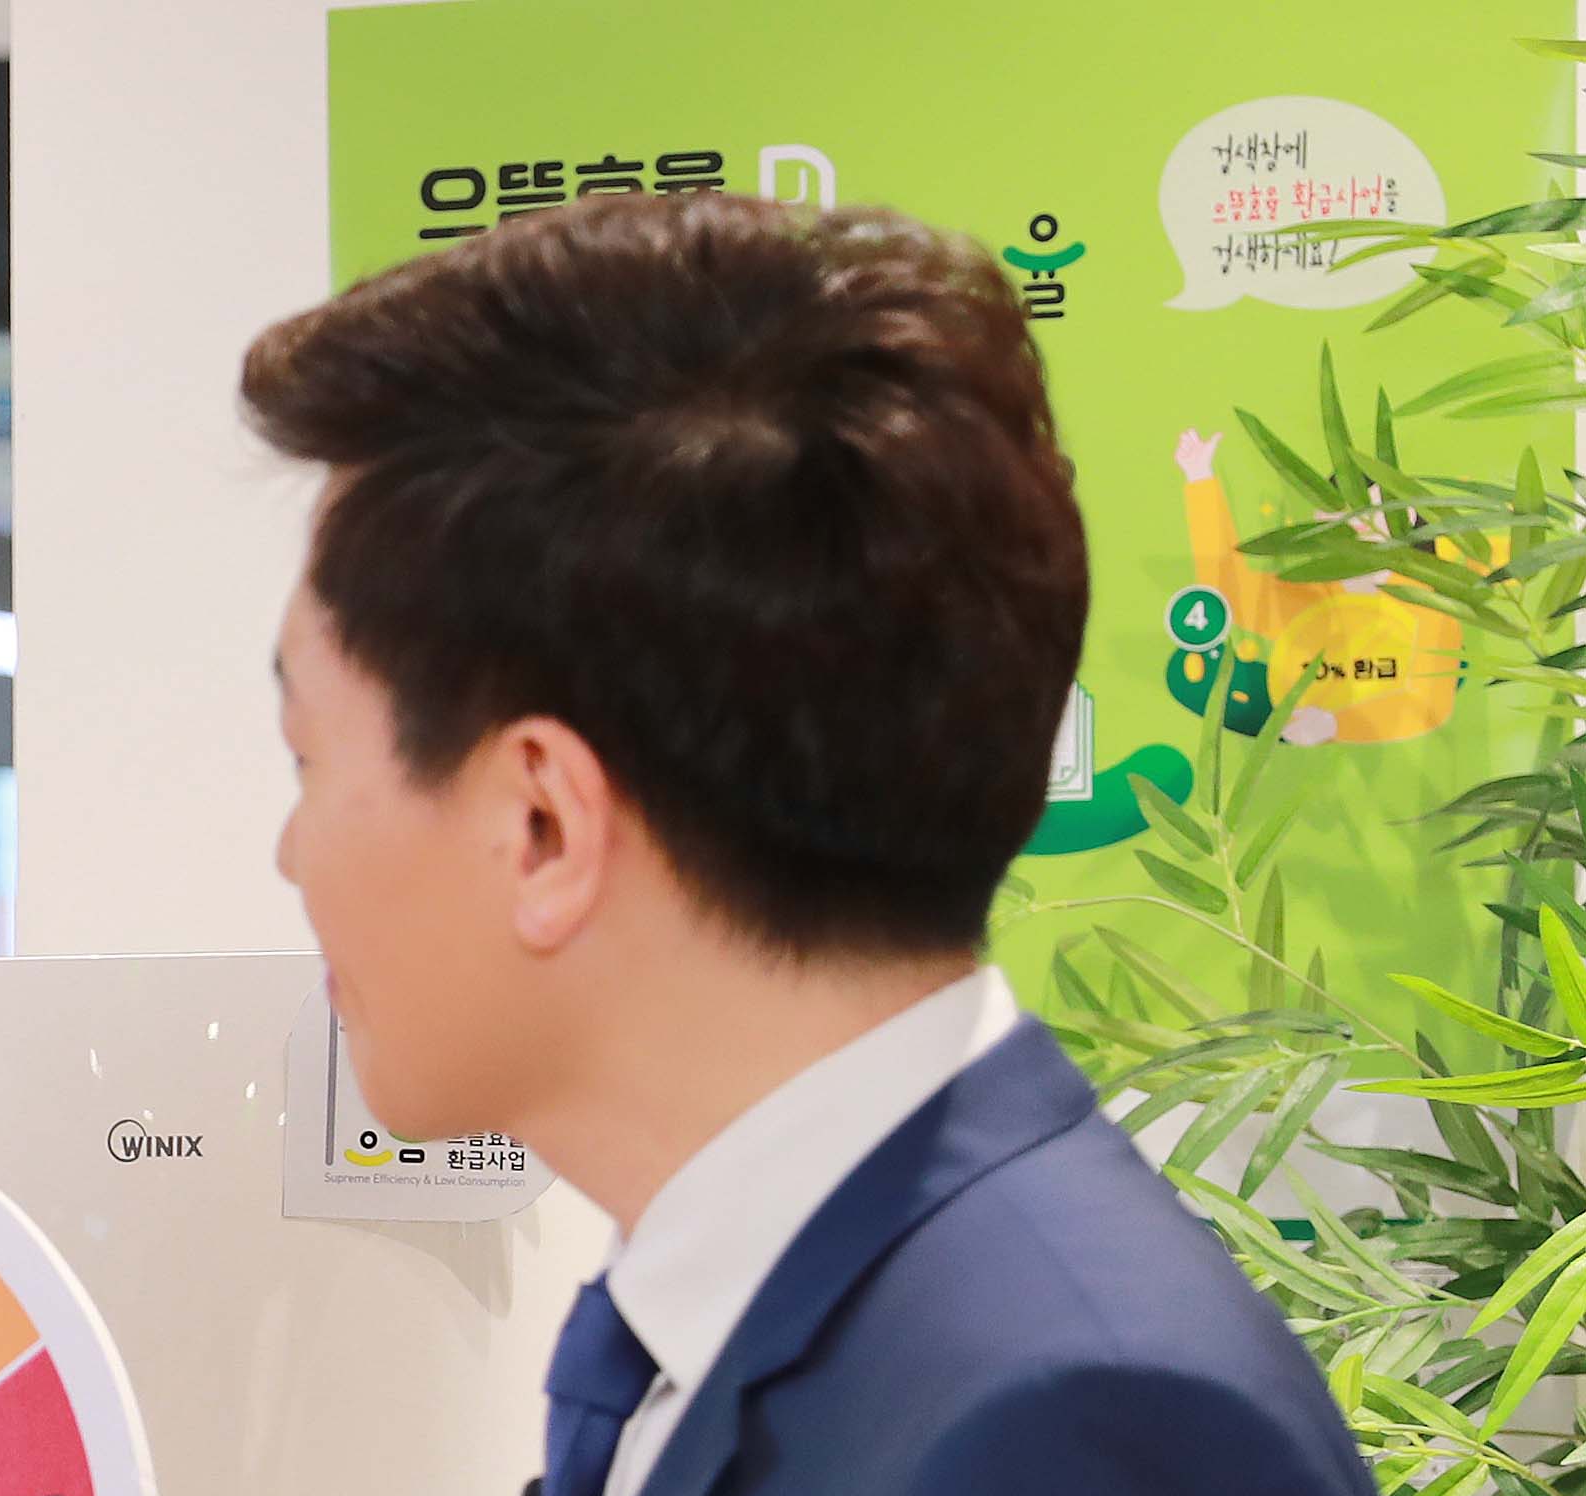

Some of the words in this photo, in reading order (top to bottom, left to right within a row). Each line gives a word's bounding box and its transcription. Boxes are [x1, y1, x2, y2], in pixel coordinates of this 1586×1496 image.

[1212, 129, 1307, 174] 검색창에
[1212, 181, 1278, 223] 으뜸효율
[1290, 174, 1399, 223] 환급사업을
[115, 1127, 204, 1160] WINIX
[446, 1150, 526, 1171] 환급사업
[324, 1172, 371, 1185] Supreme
[373, 1173, 422, 1187] Efficiency
[434, 1175, 456, 1186] Low
[458, 1175, 526, 1188] Consumption
